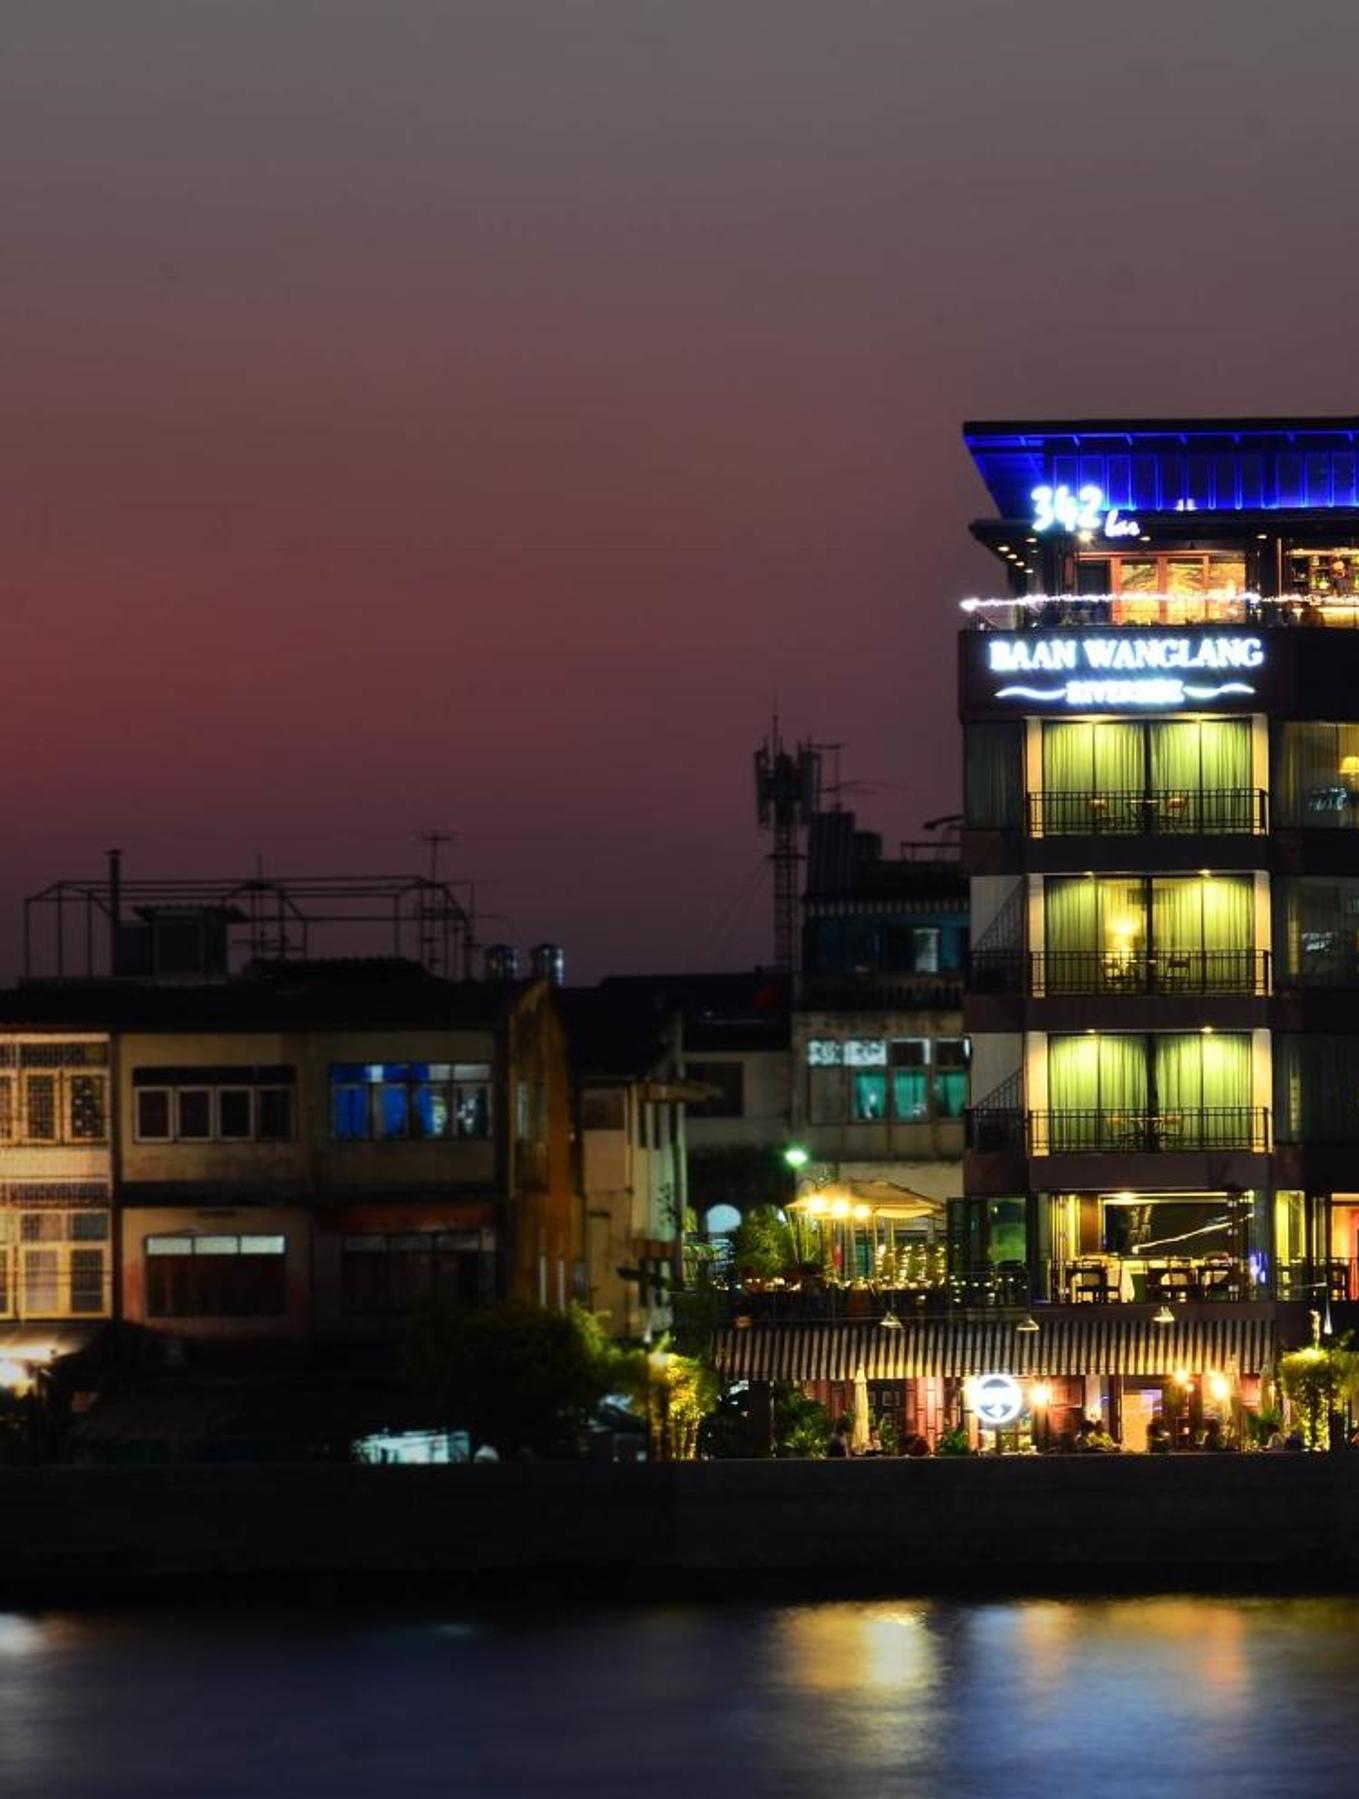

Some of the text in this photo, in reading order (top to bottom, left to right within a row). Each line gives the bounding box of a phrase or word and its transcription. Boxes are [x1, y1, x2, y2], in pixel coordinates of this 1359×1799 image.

[1030, 484, 1103, 532] 342
[988, 637, 1264, 671] BAAN WANGLANG
